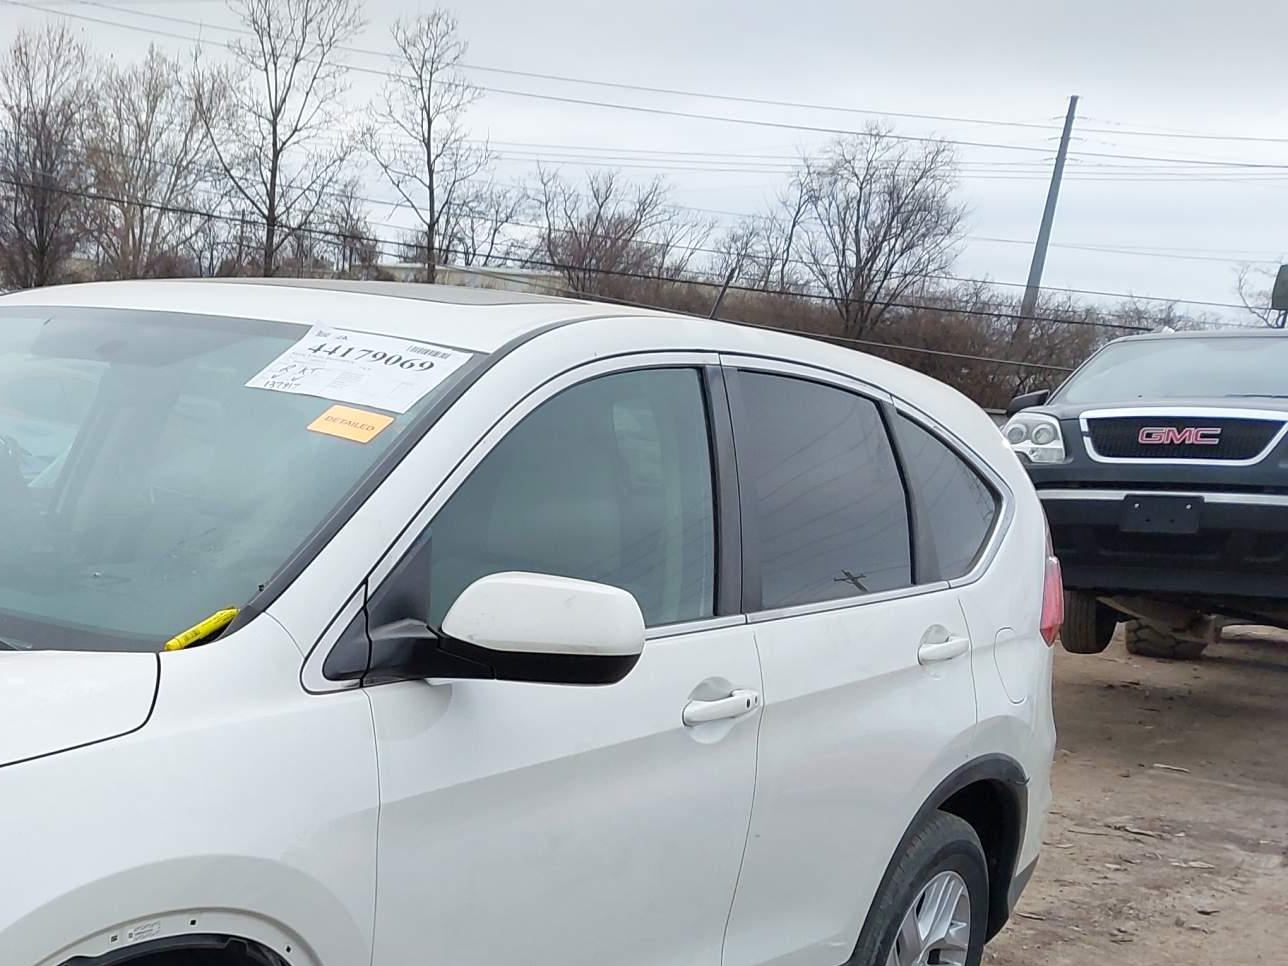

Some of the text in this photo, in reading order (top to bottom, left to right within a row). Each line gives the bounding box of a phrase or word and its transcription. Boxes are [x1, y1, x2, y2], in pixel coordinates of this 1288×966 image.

[308, 343, 434, 372] 44179069
[324, 415, 376, 431] DETAILED
[1139, 427, 1221, 444] GMC
